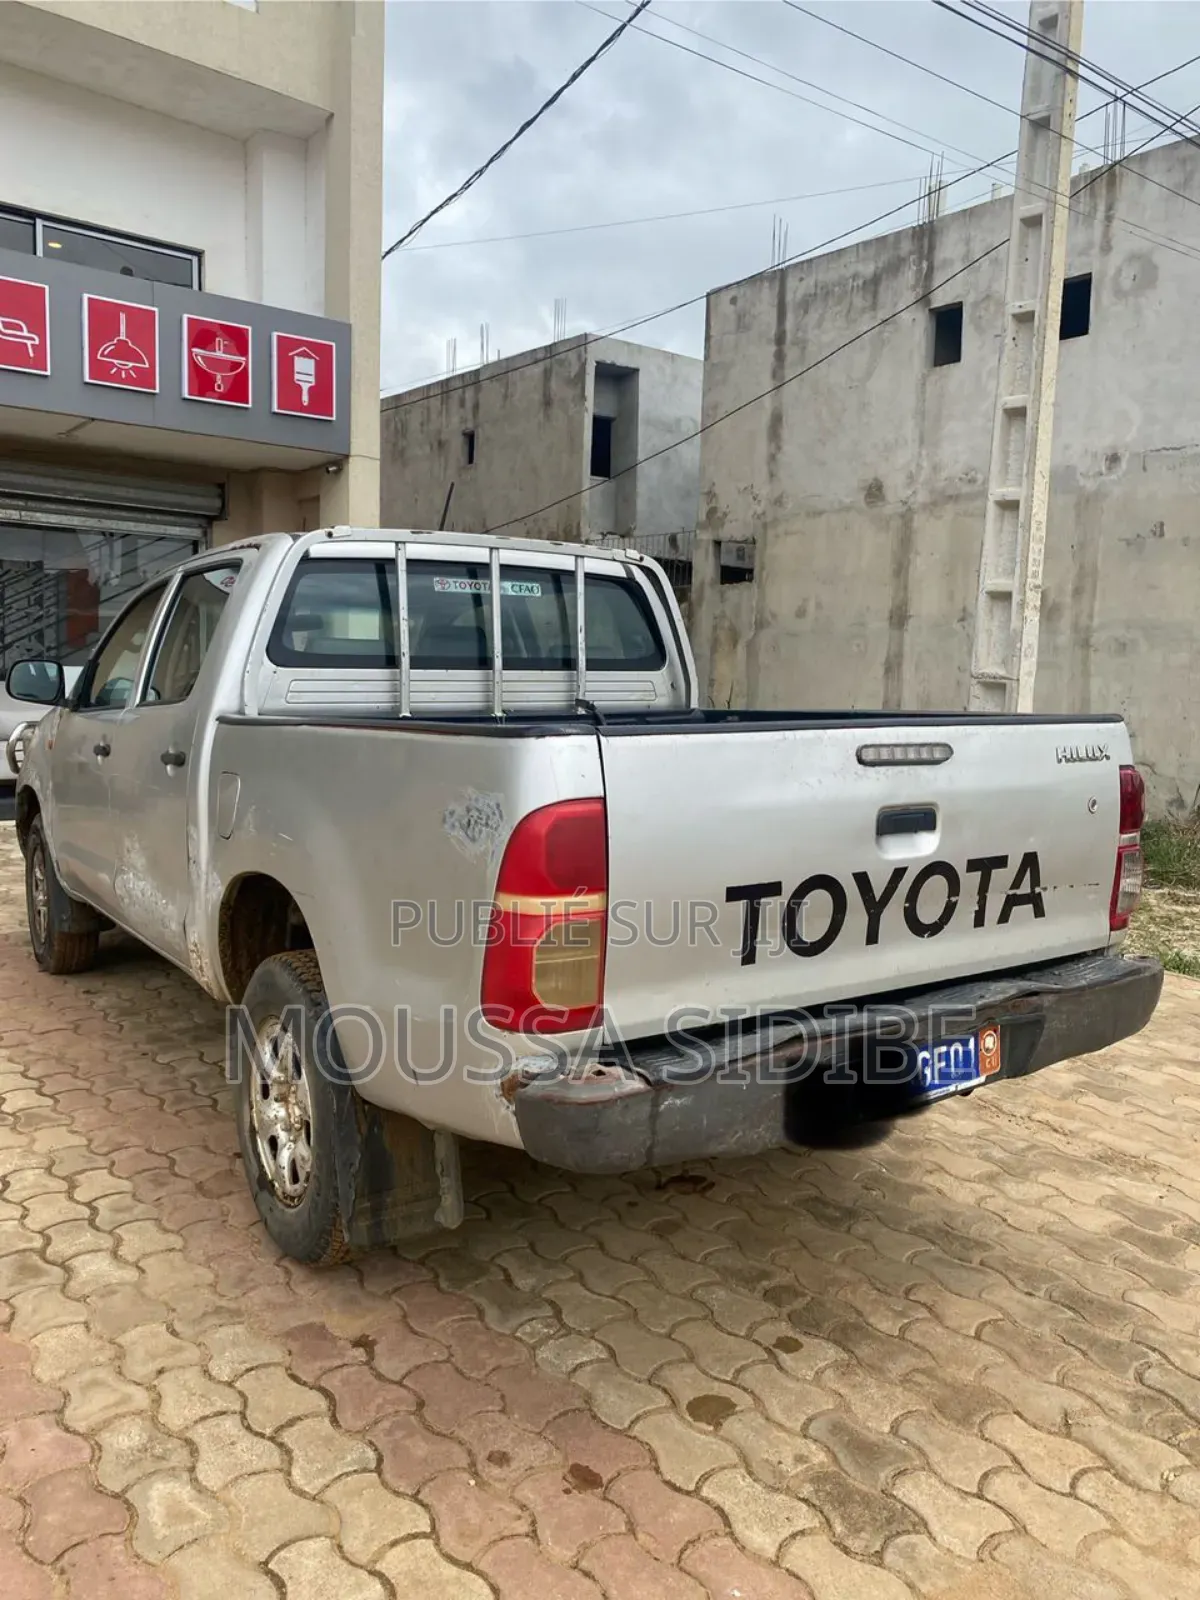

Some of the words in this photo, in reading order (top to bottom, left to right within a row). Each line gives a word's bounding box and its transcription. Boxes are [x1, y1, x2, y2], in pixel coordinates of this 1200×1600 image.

[453, 580, 491, 592] TOYOT
[510, 583, 540, 595] CFAO
[1055, 744, 1111, 764] HILUX
[725, 851, 1046, 966] TOYOTA
